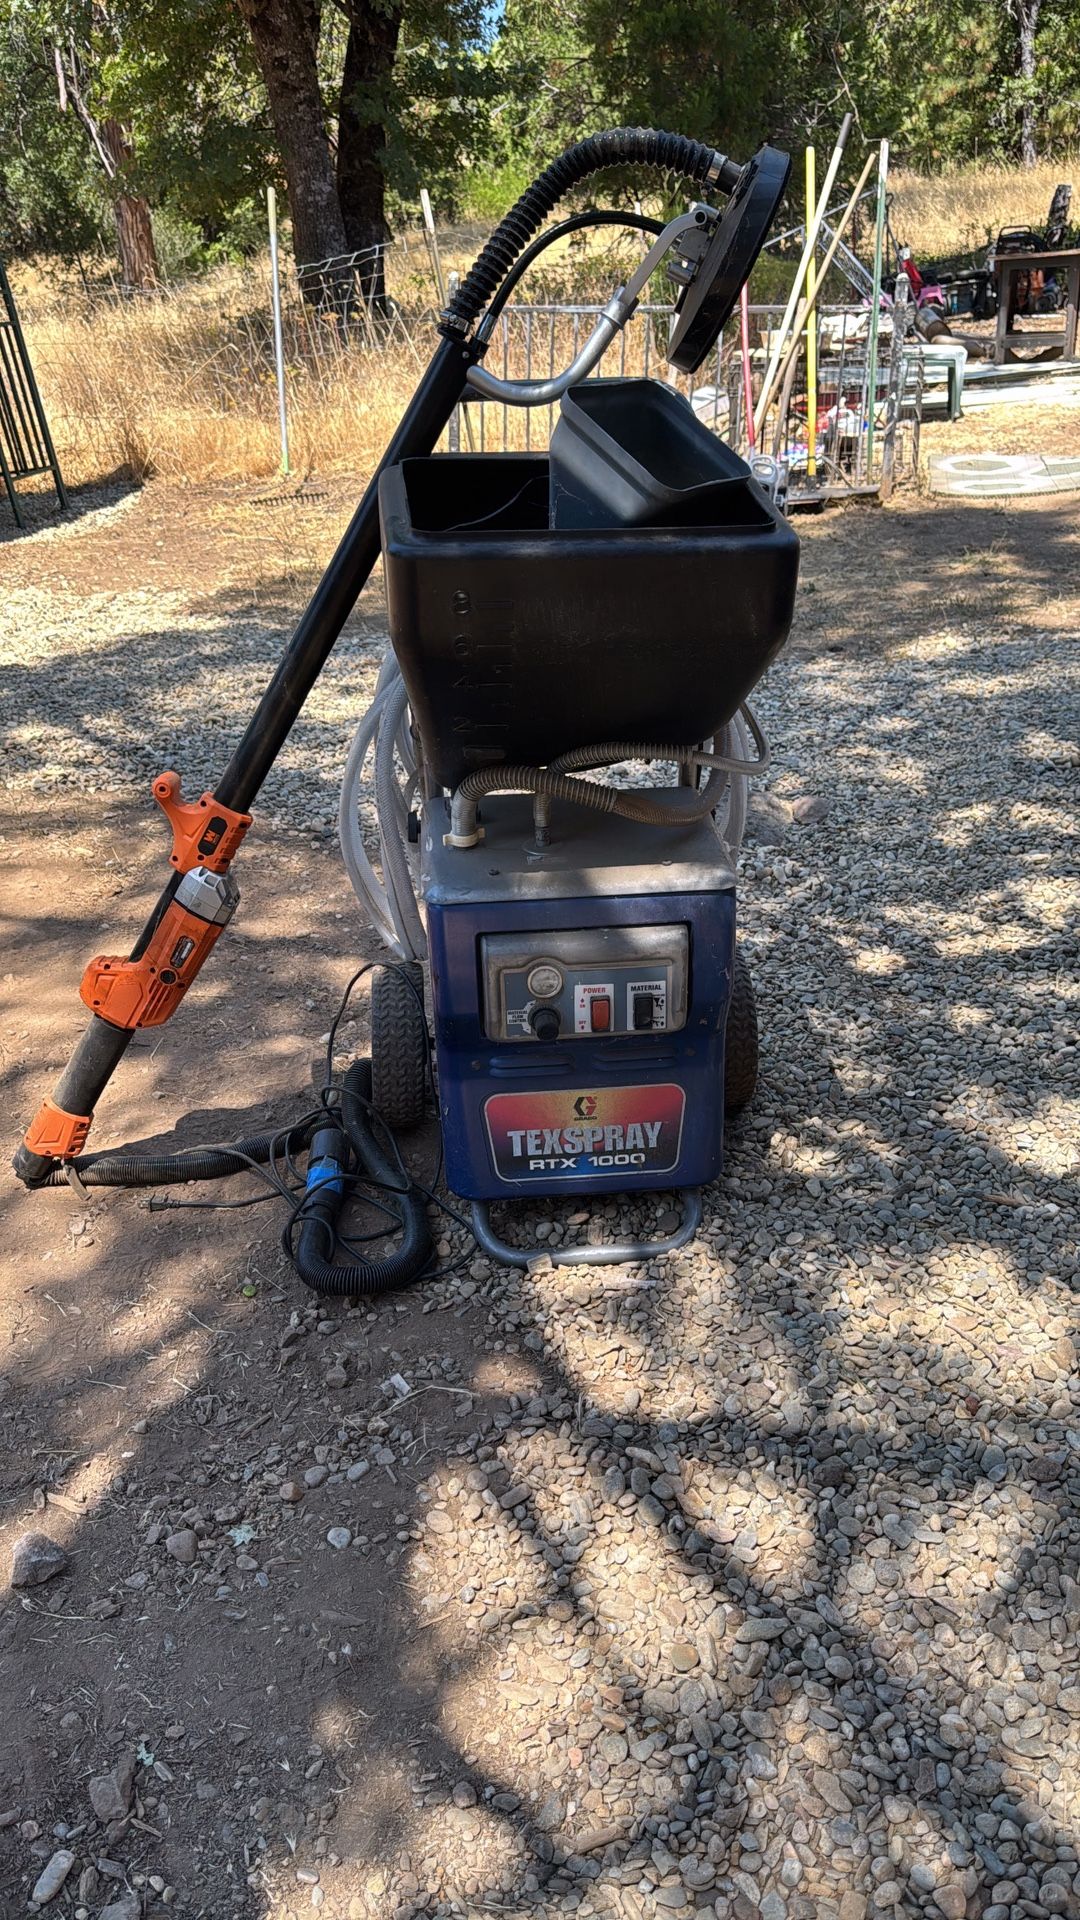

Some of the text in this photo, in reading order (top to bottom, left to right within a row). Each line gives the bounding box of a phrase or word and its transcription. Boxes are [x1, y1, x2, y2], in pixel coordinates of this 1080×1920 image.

[630, 984, 662, 992] MATERIAL
[506, 1121, 663, 1157] TEXSPRAY
[529, 1152, 646, 1170] RTX 1000
